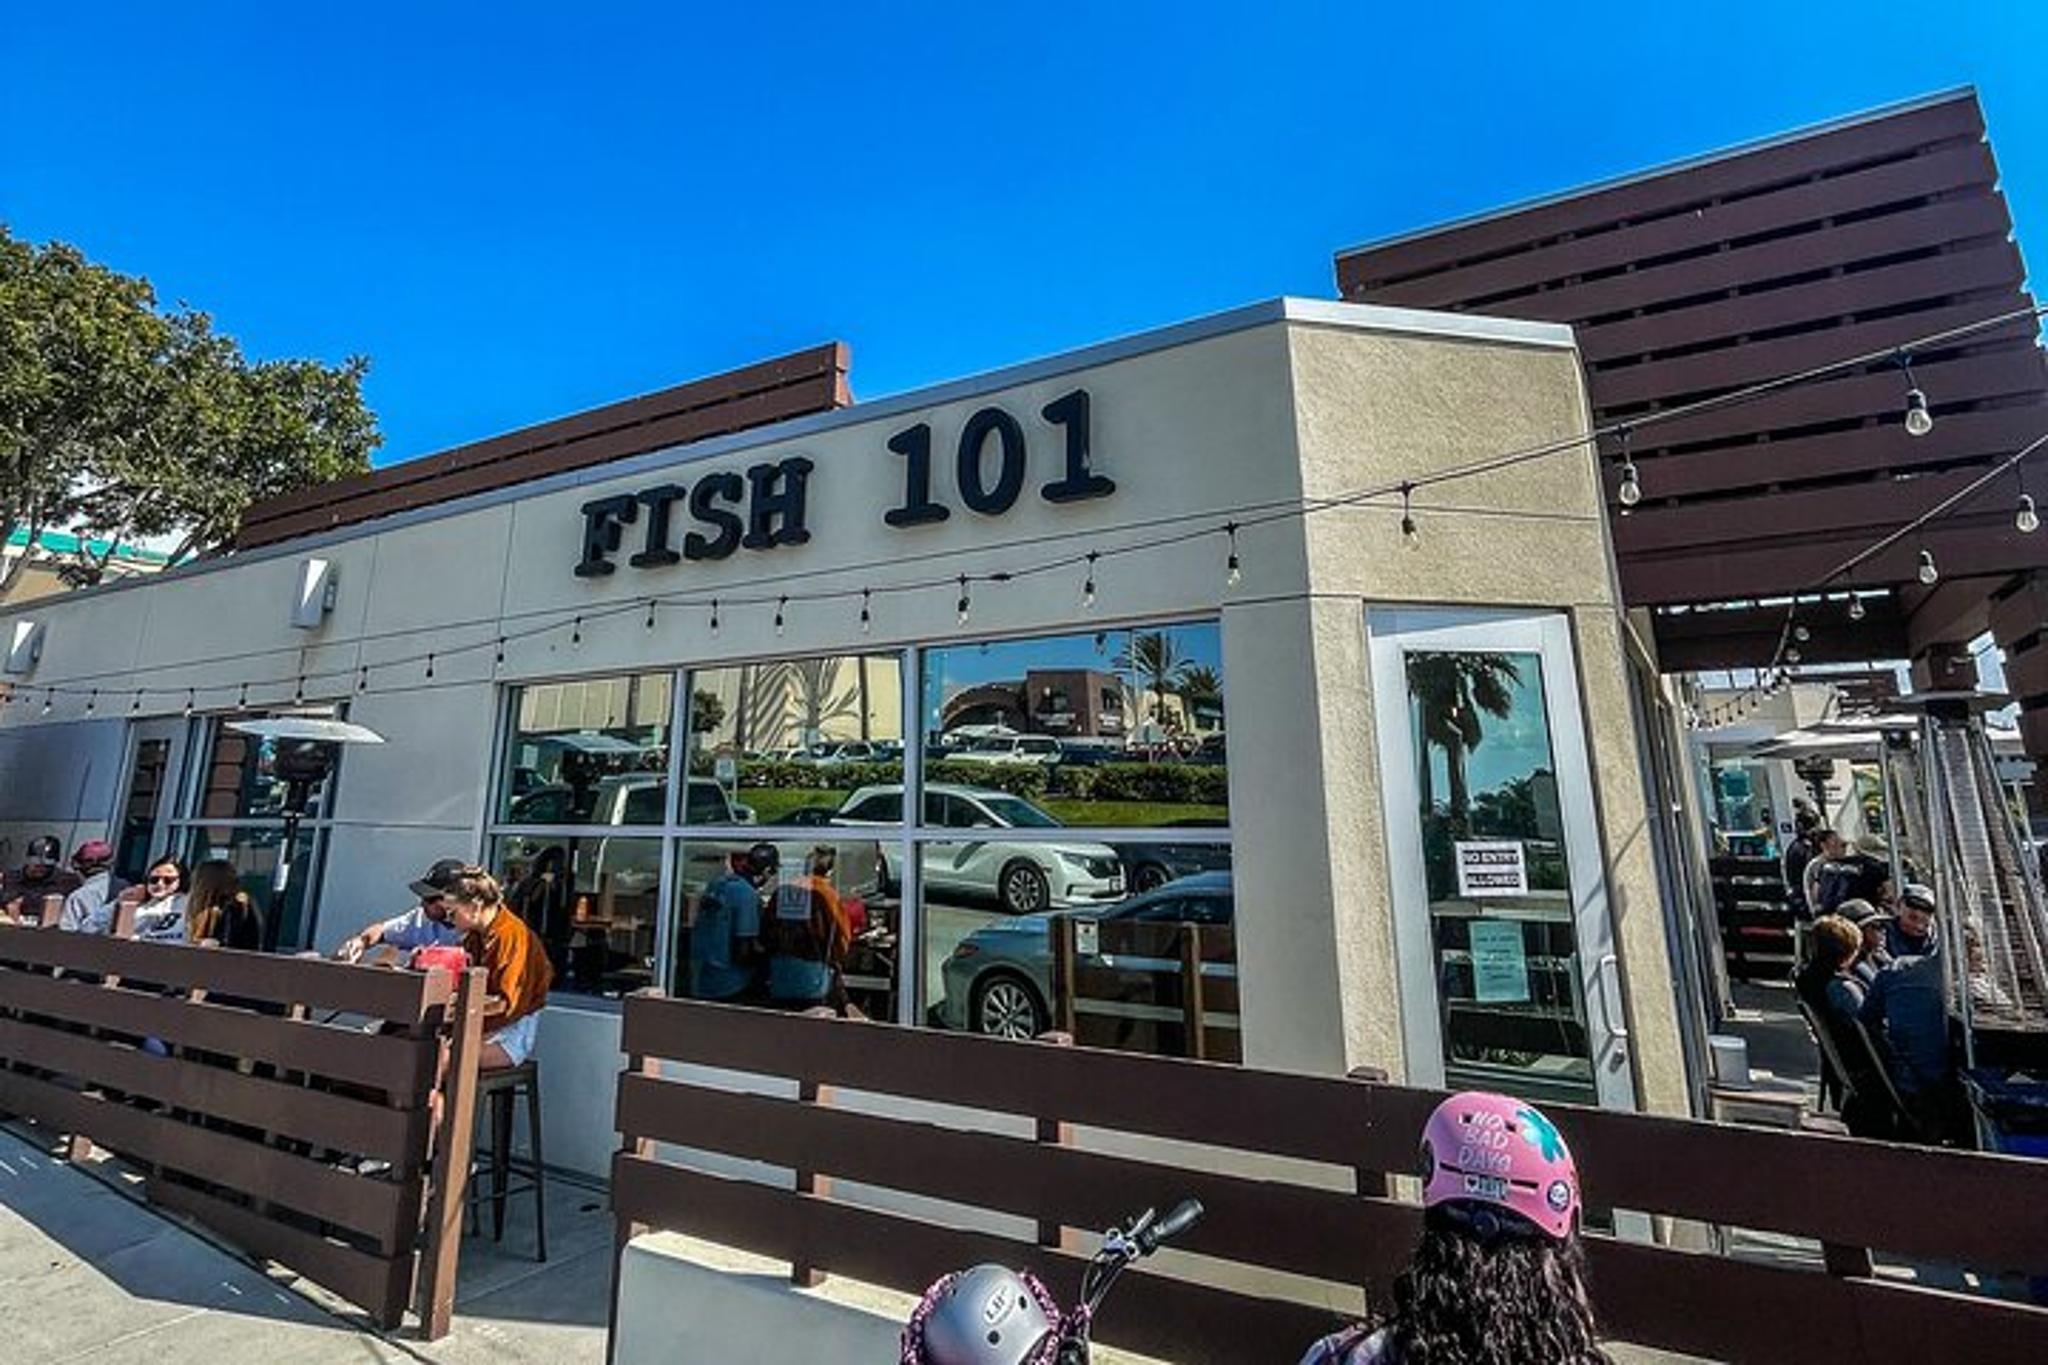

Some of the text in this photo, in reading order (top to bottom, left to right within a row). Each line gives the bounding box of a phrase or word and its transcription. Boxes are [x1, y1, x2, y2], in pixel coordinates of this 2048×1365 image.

[574, 389, 1116, 578] FISH 101
[1471, 1111, 1505, 1131] NO
[1464, 1127, 1509, 1150] BAD
